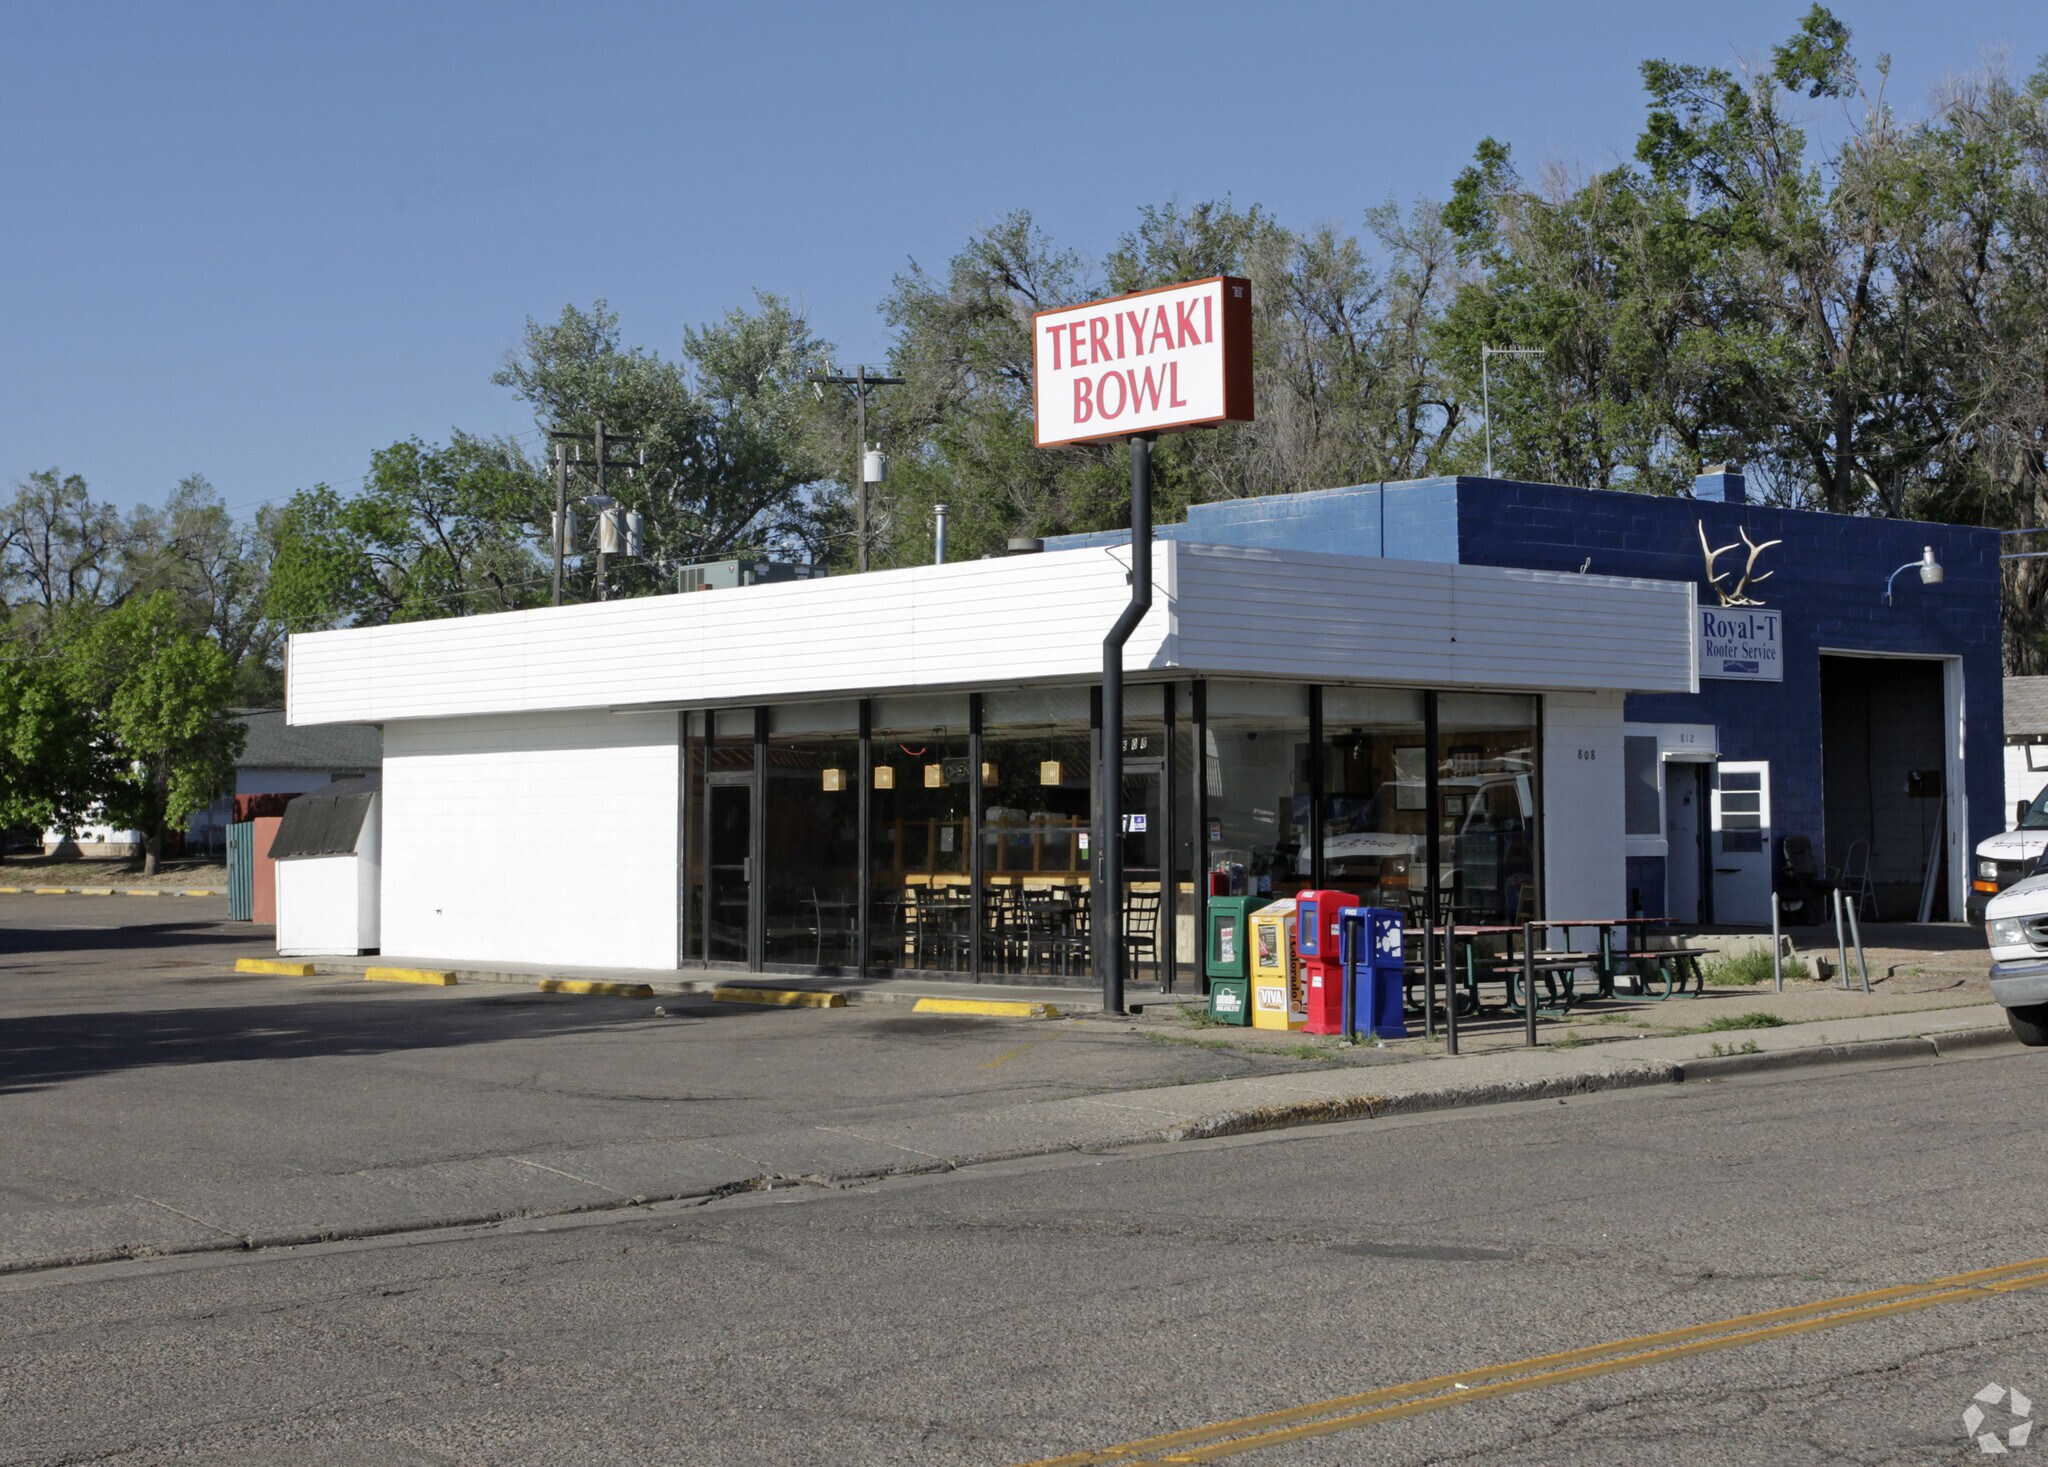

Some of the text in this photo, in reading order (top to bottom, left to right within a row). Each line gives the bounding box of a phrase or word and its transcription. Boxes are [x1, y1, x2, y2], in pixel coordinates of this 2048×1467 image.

[1045, 295, 1214, 371] TERIYAKI
[1073, 360, 1187, 424] BOWL
[1702, 611, 1778, 643] Royal-T
[1706, 639, 1776, 660] Rooter Service
[1680, 734, 1694, 743] 812
[1577, 749, 1596, 760] 808
[1344, 908, 1358, 916] FREE
[1290, 941, 1300, 999] Colorado
[1260, 988, 1283, 1004] VIVA
